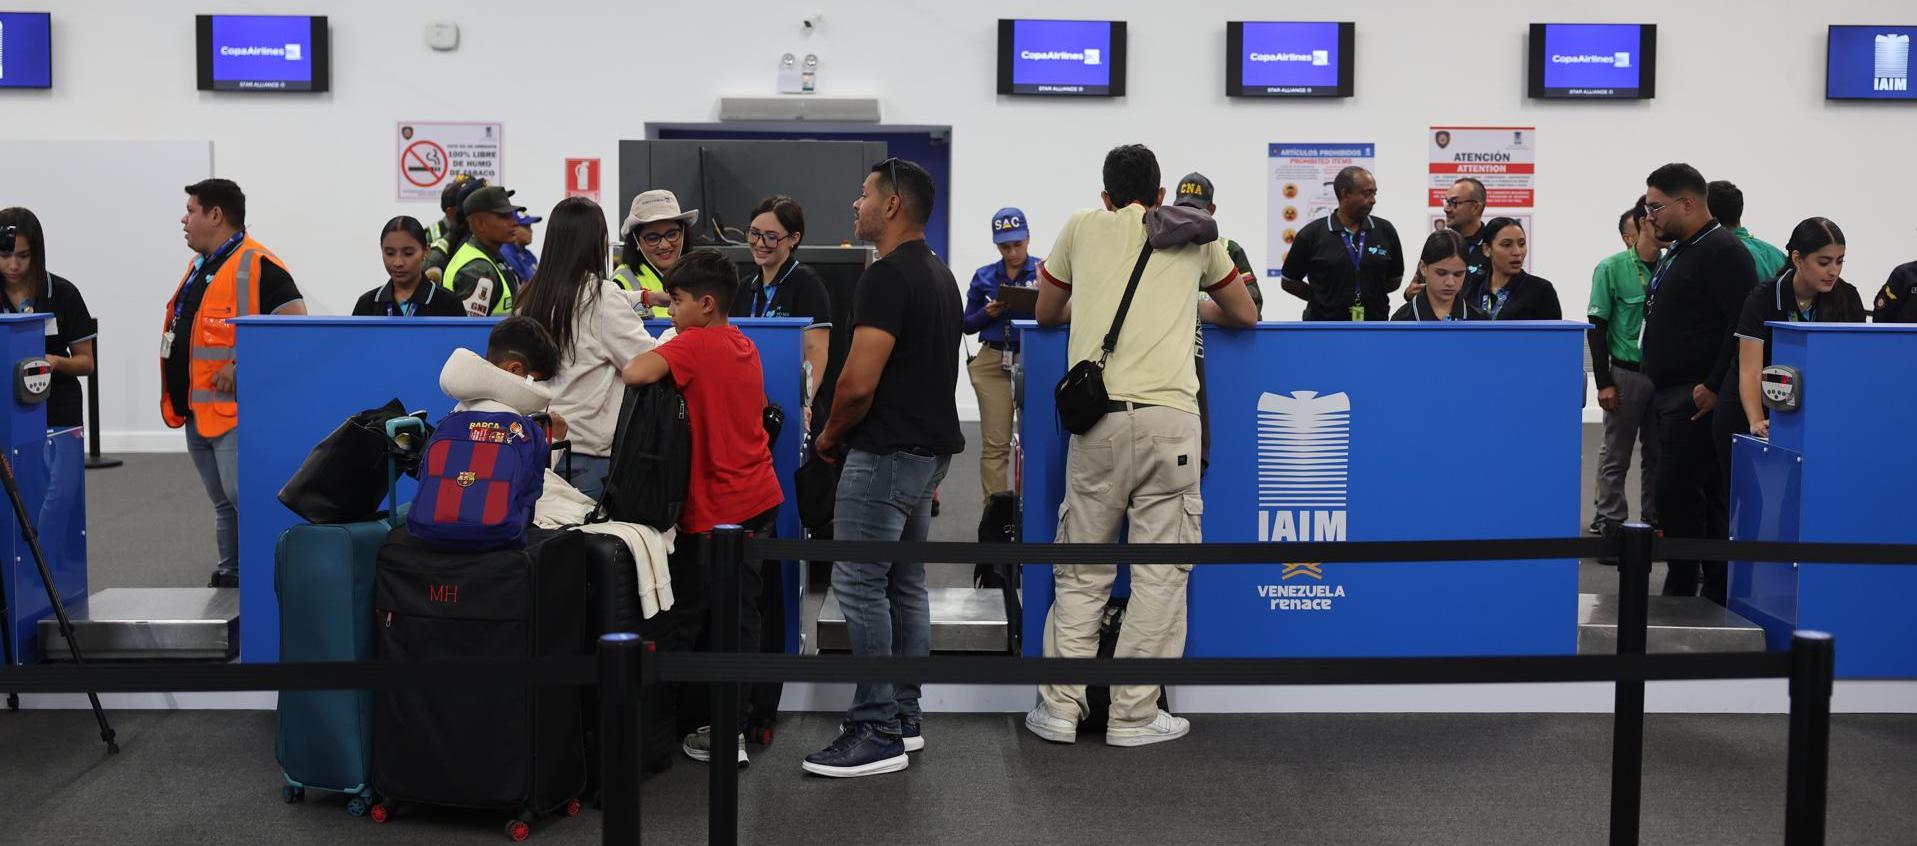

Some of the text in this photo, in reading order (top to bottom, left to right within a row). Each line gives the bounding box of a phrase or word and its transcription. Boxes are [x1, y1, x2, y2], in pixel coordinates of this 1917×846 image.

[220, 45, 285, 57] CopaAirlines
[1020, 50, 1084, 61] CopaAirlines
[1249, 52, 1313, 62] CopaAirlines
[1551, 54, 1614, 64] CopaAirlines
[1873, 77, 1908, 91] IAIM
[1454, 149, 1511, 162] ATENCIÓN
[1456, 164, 1507, 173] ATTENTION
[1181, 182, 1202, 195] CNA
[994, 216, 1020, 230] SAC
[1258, 510, 1347, 542] IAIM
[430, 583, 458, 603] MH
[1257, 585, 1346, 597] VENEZUELA
[1270, 598, 1332, 610] renace
